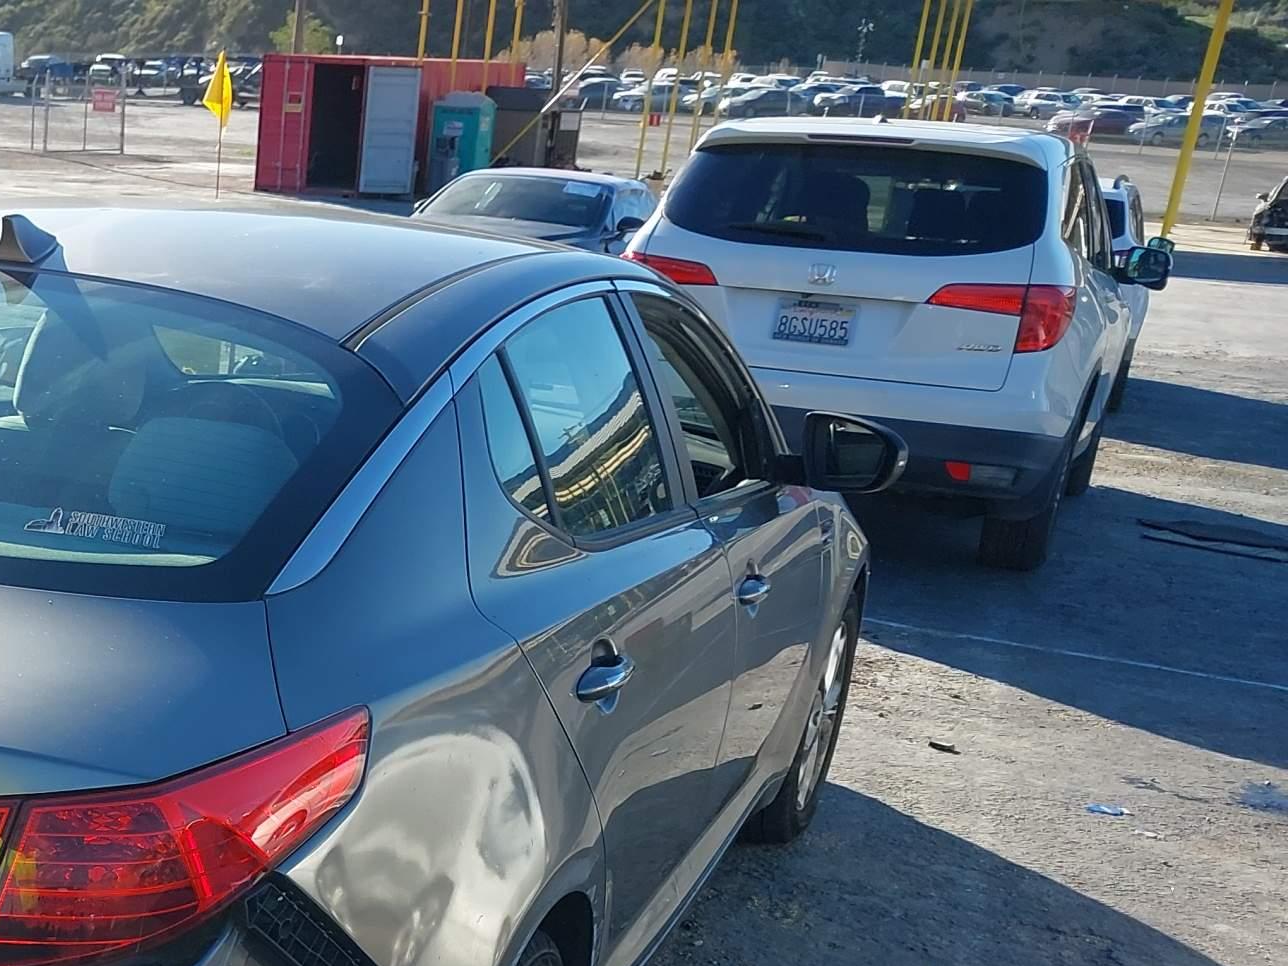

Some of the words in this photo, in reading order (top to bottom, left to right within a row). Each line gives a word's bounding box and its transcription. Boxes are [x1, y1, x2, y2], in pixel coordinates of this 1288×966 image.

[777, 315, 849, 340] 8GSU585
[64, 522, 99, 539] LAW
[102, 527, 161, 549] SCHOOL
[68, 511, 166, 537] SOUTHWESTERN
